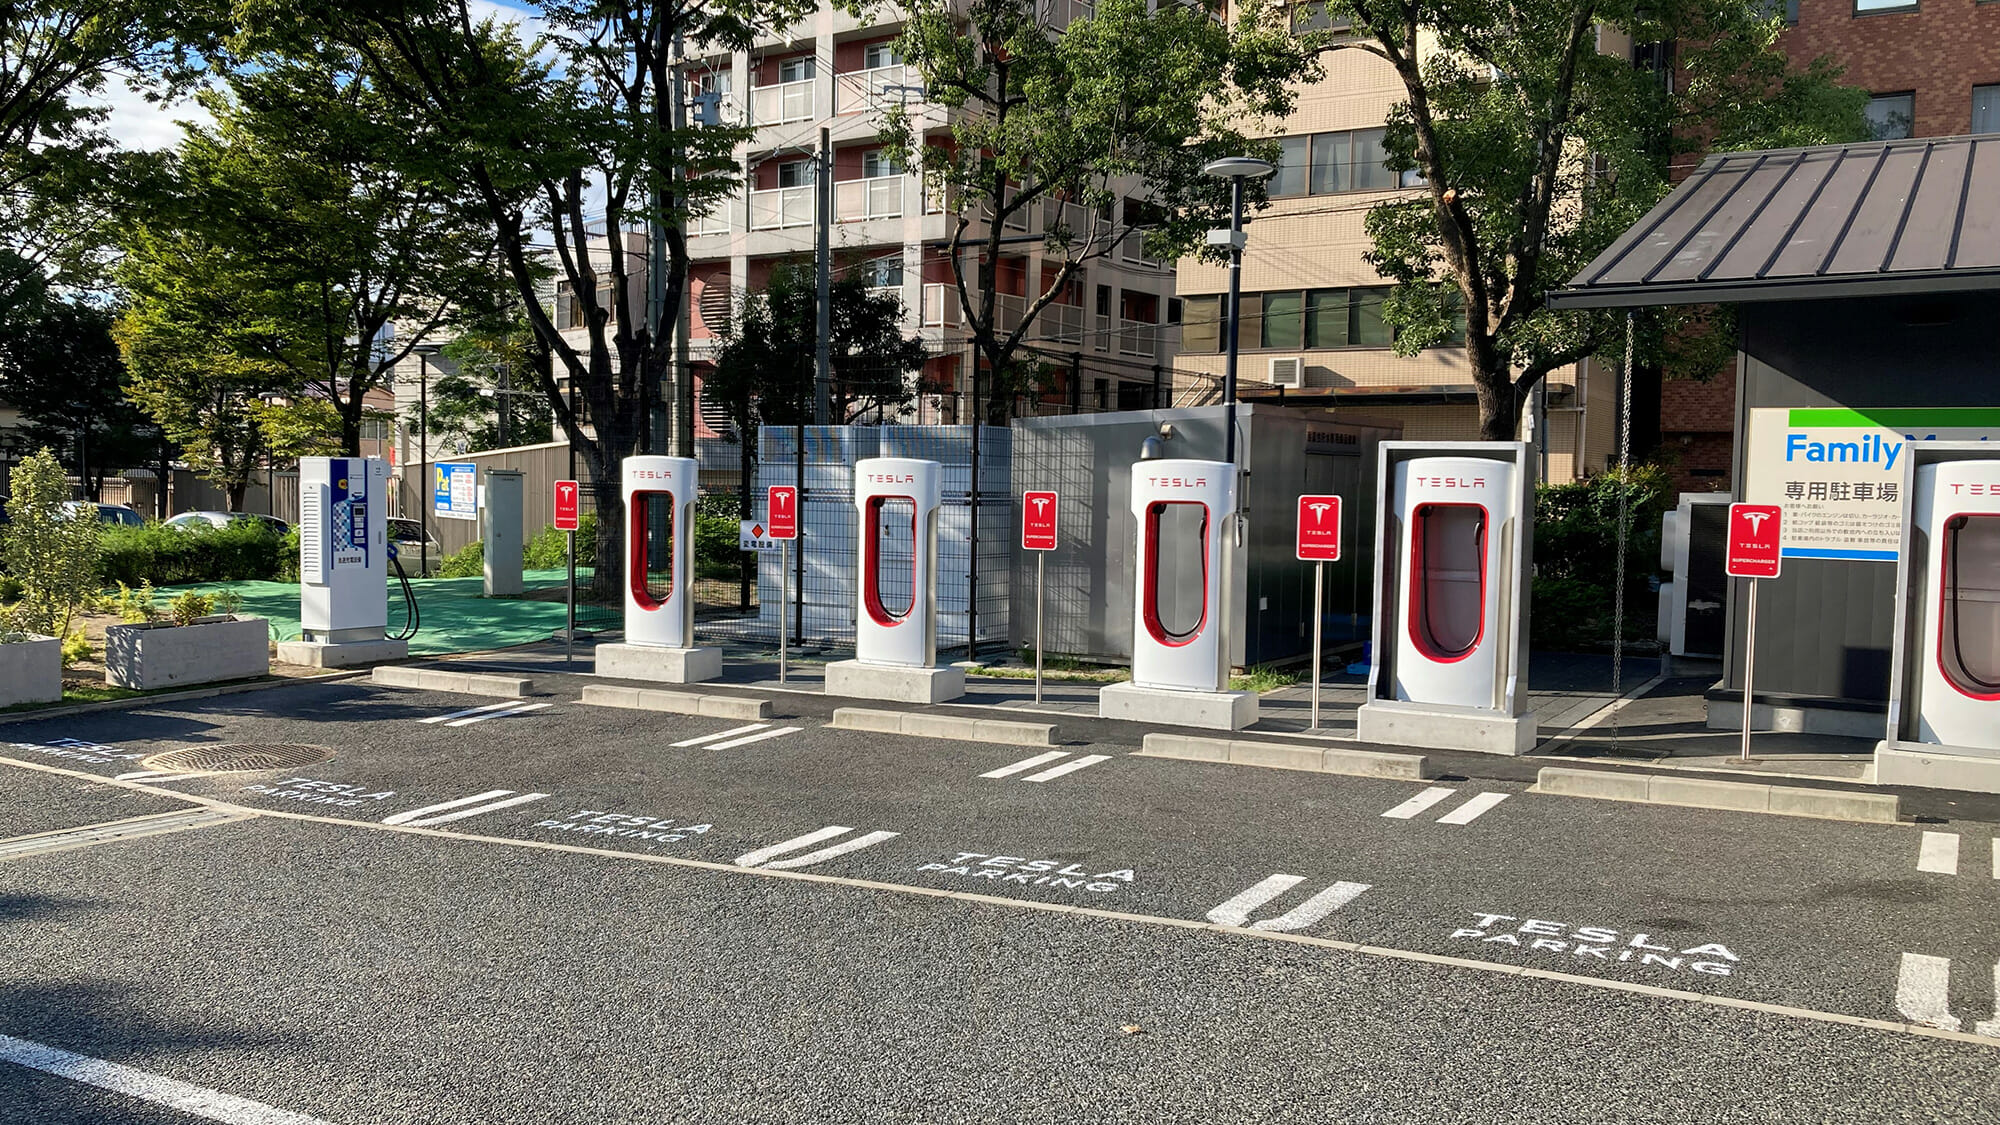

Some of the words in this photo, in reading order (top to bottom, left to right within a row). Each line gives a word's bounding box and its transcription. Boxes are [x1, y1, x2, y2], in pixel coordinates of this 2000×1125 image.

[1786, 434, 1902, 471] Family
[632, 470, 672, 479] TESLA
[867, 474, 914, 484] TESLA
[1149, 477, 1206, 487] TESLA
[1416, 477, 1485, 488] TESLA
[1784, 480, 1899, 502] 専用駐車場
[276, 777, 395, 800] TESLA
[530, 819, 687, 843] PARKING
[567, 809, 713, 834] TESLA
[915, 862, 1120, 893] PARKING
[950, 851, 1135, 882] TESLA
[1472, 911, 1740, 962] TESLA
[1450, 927, 1732, 977] PARKING
